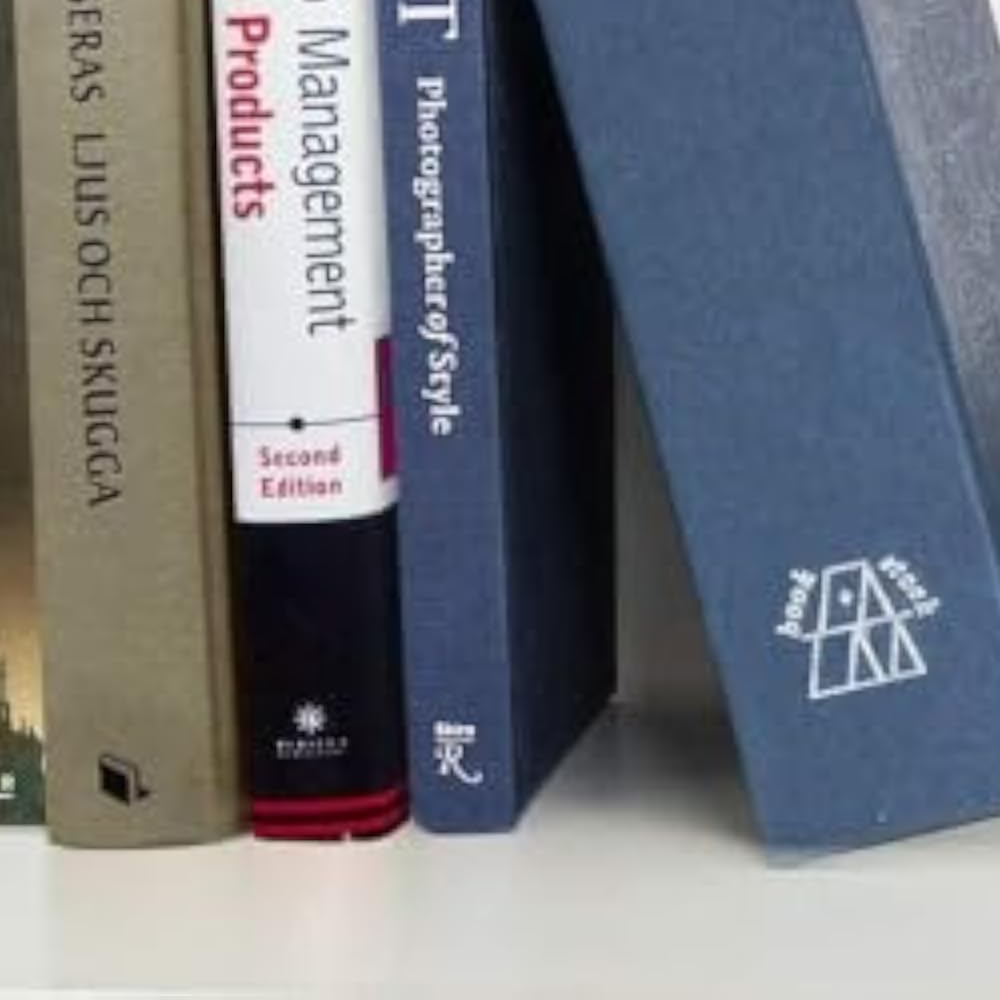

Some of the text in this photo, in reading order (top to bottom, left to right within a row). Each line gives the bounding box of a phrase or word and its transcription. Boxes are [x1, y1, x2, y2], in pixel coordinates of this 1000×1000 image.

[225, 17, 273, 219] Products
[71, 133, 108, 226] LJUS
[293, 29, 356, 336] Management
[77, 238, 113, 326] OCH
[81, 340, 122, 507] SKUGGA
[259, 444, 342, 467] Second
[260, 476, 343, 499] Edition
